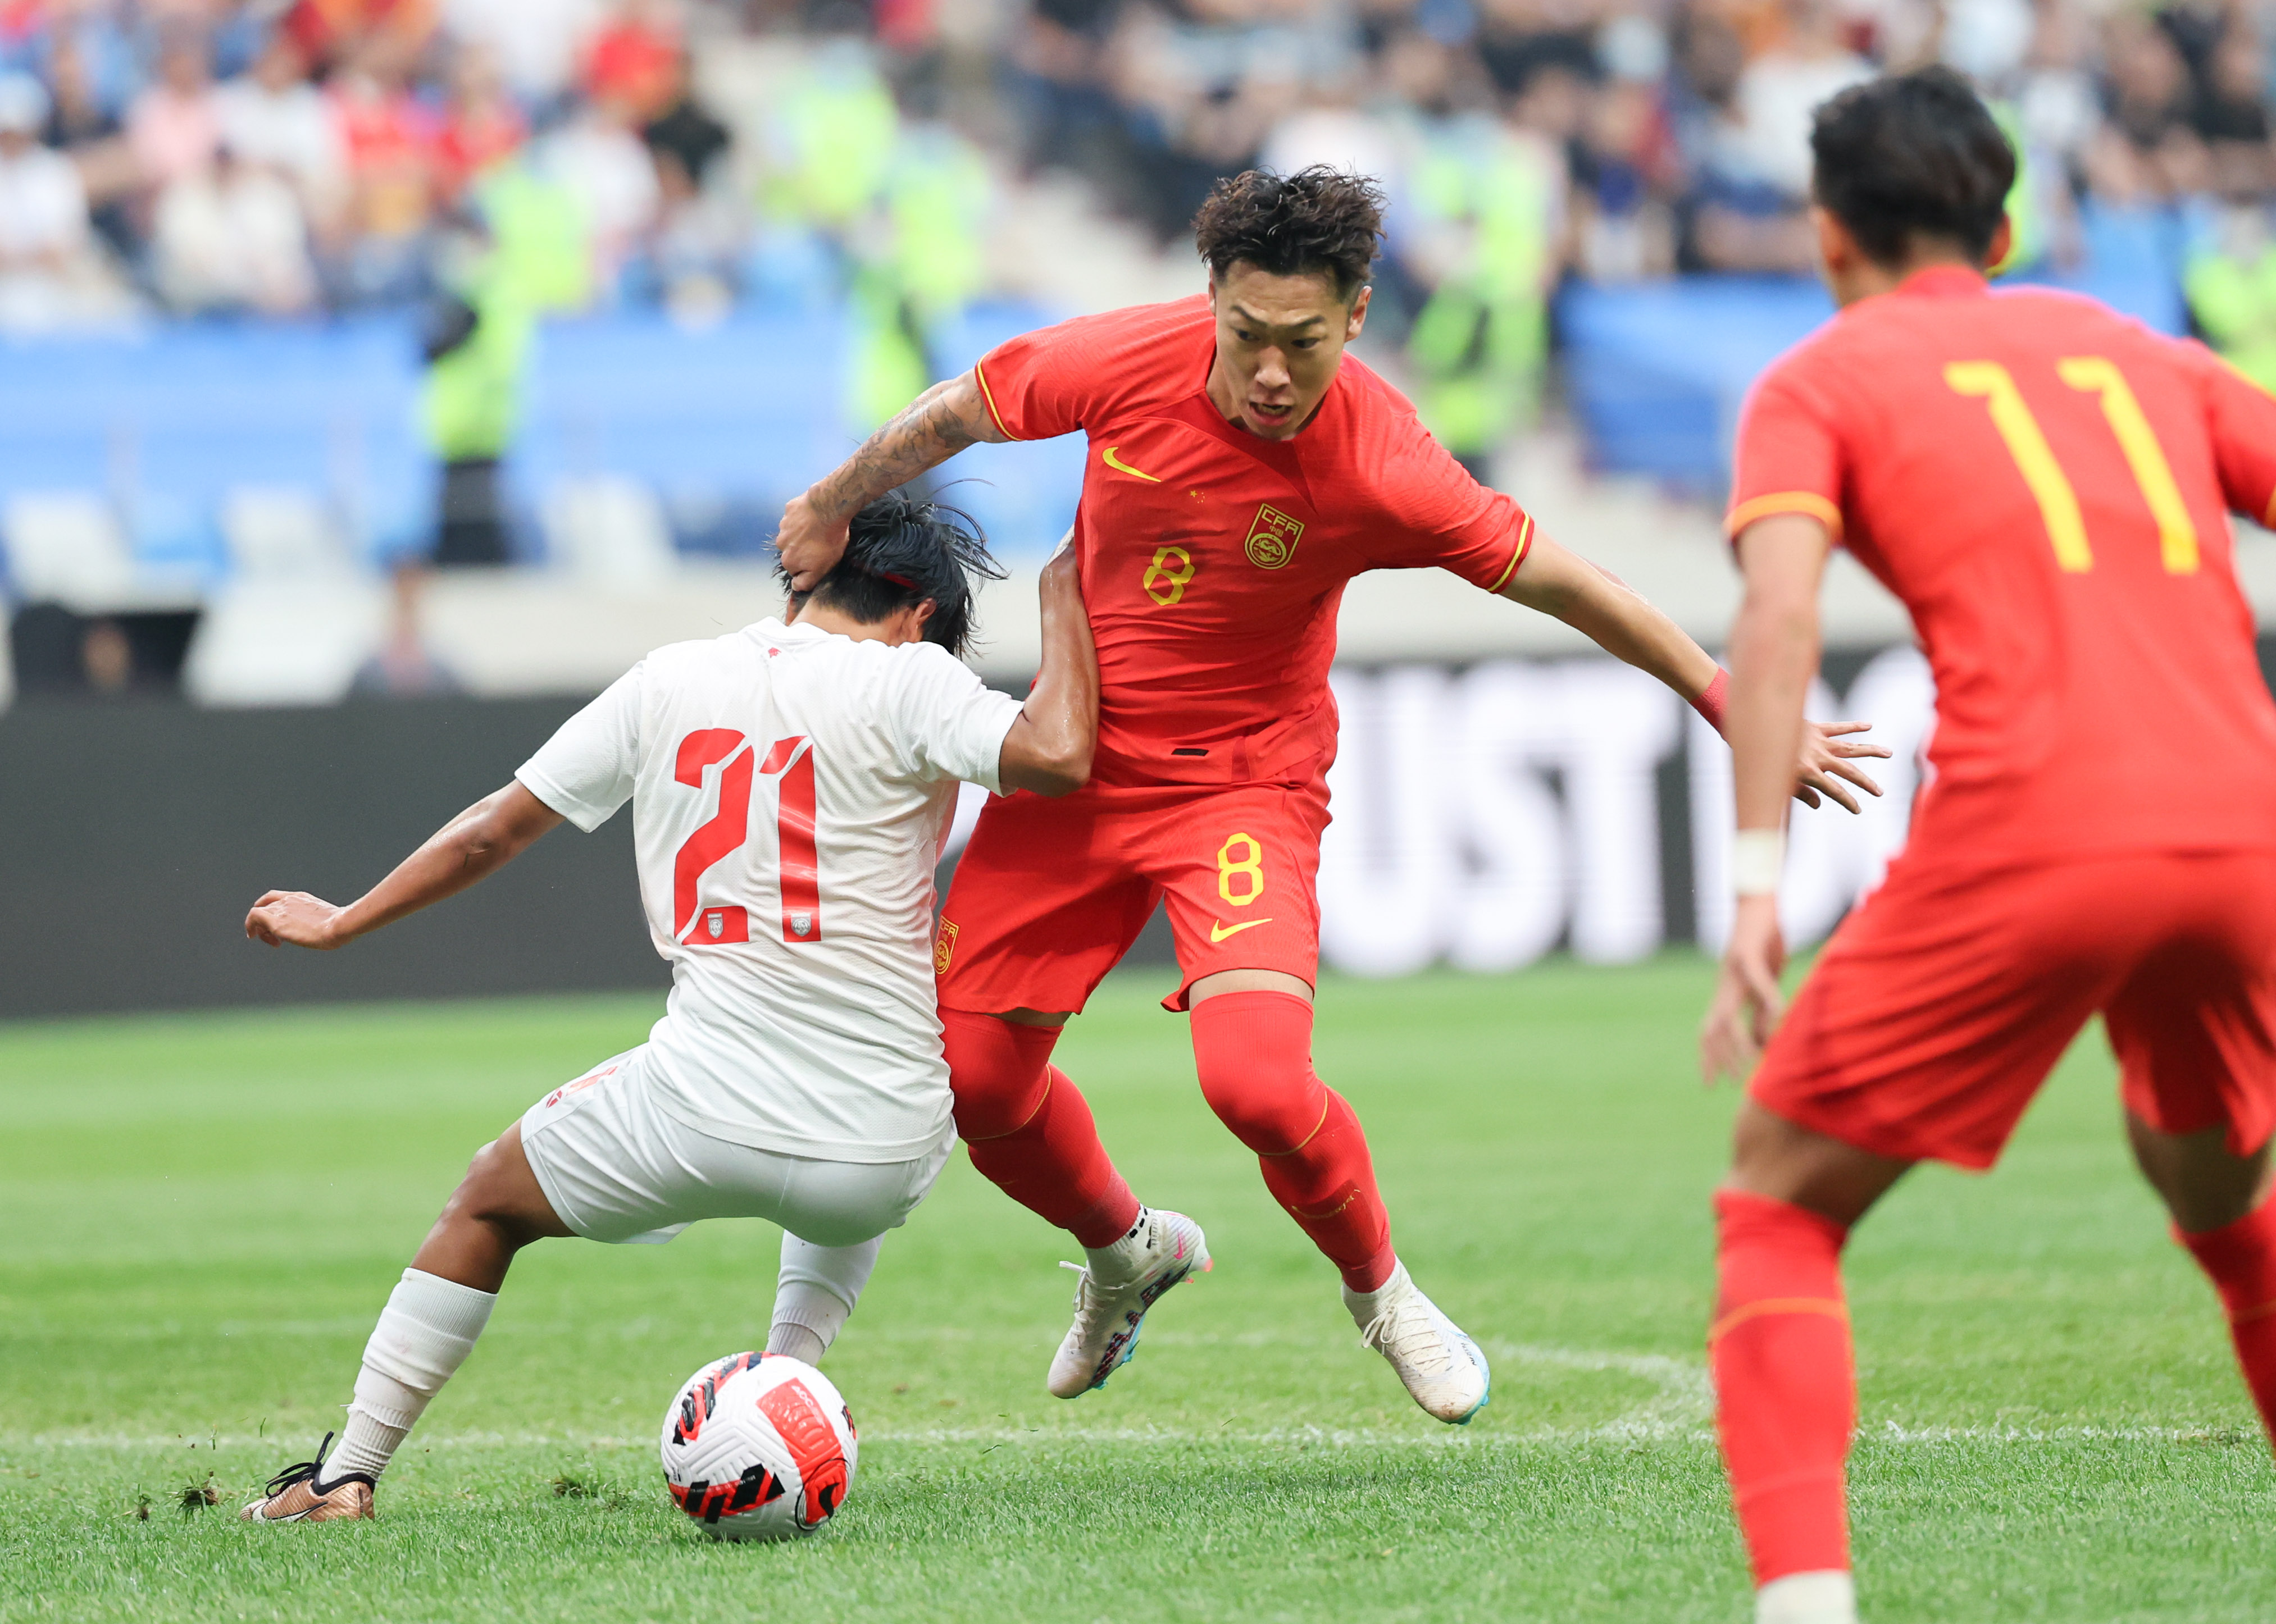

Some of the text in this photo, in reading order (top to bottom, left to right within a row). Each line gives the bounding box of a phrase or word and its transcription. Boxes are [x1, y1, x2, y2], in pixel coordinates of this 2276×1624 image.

[1261, 508, 1299, 536] CFA
[1942, 355, 2200, 576] 11
[1144, 546, 1195, 605] 8
[674, 728, 822, 946] 21
[1218, 832, 1264, 906] 8
[1315, 658, 1677, 974] UST
